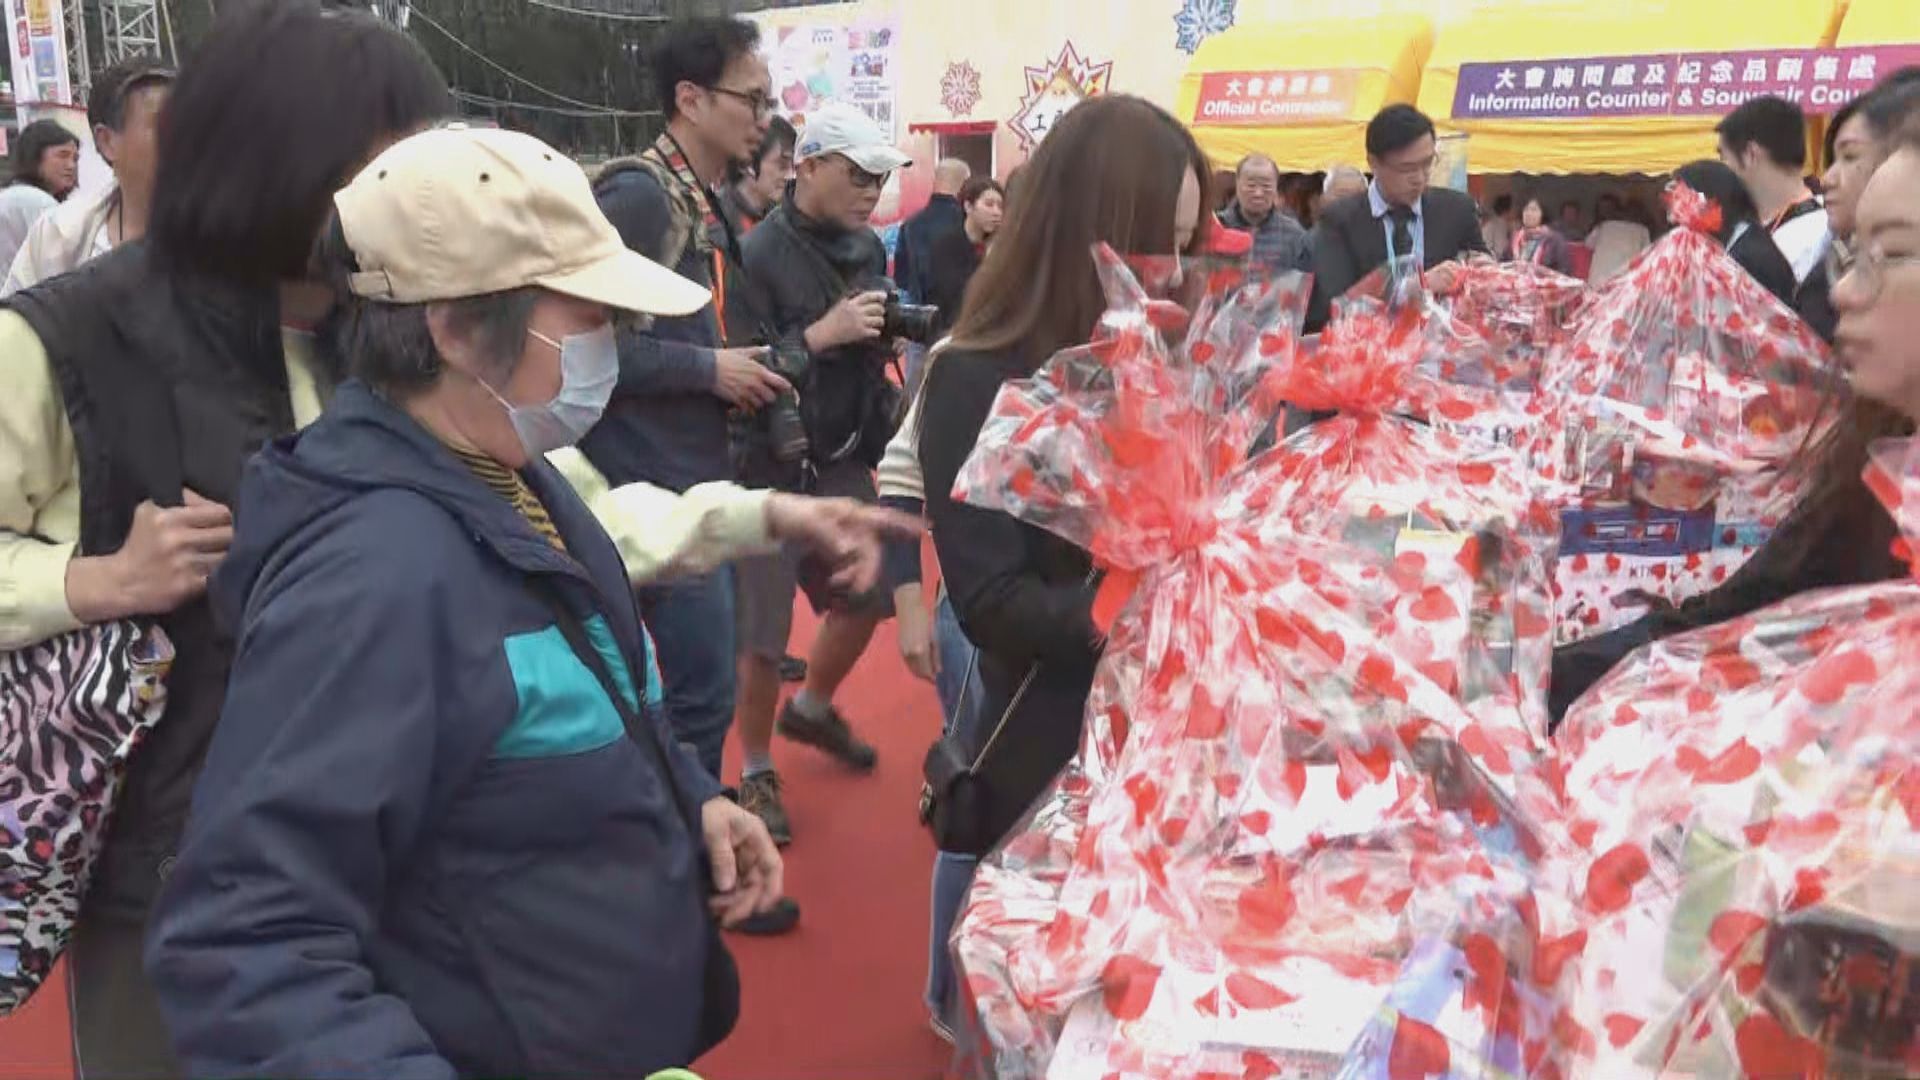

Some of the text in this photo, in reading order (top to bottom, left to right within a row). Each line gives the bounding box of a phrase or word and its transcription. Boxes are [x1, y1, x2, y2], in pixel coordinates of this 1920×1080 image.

[1203, 101, 1256, 116] Official
[1469, 93, 1580, 111] Information
[1586, 91, 1668, 108] Counter
[1678, 87, 1693, 106] &
